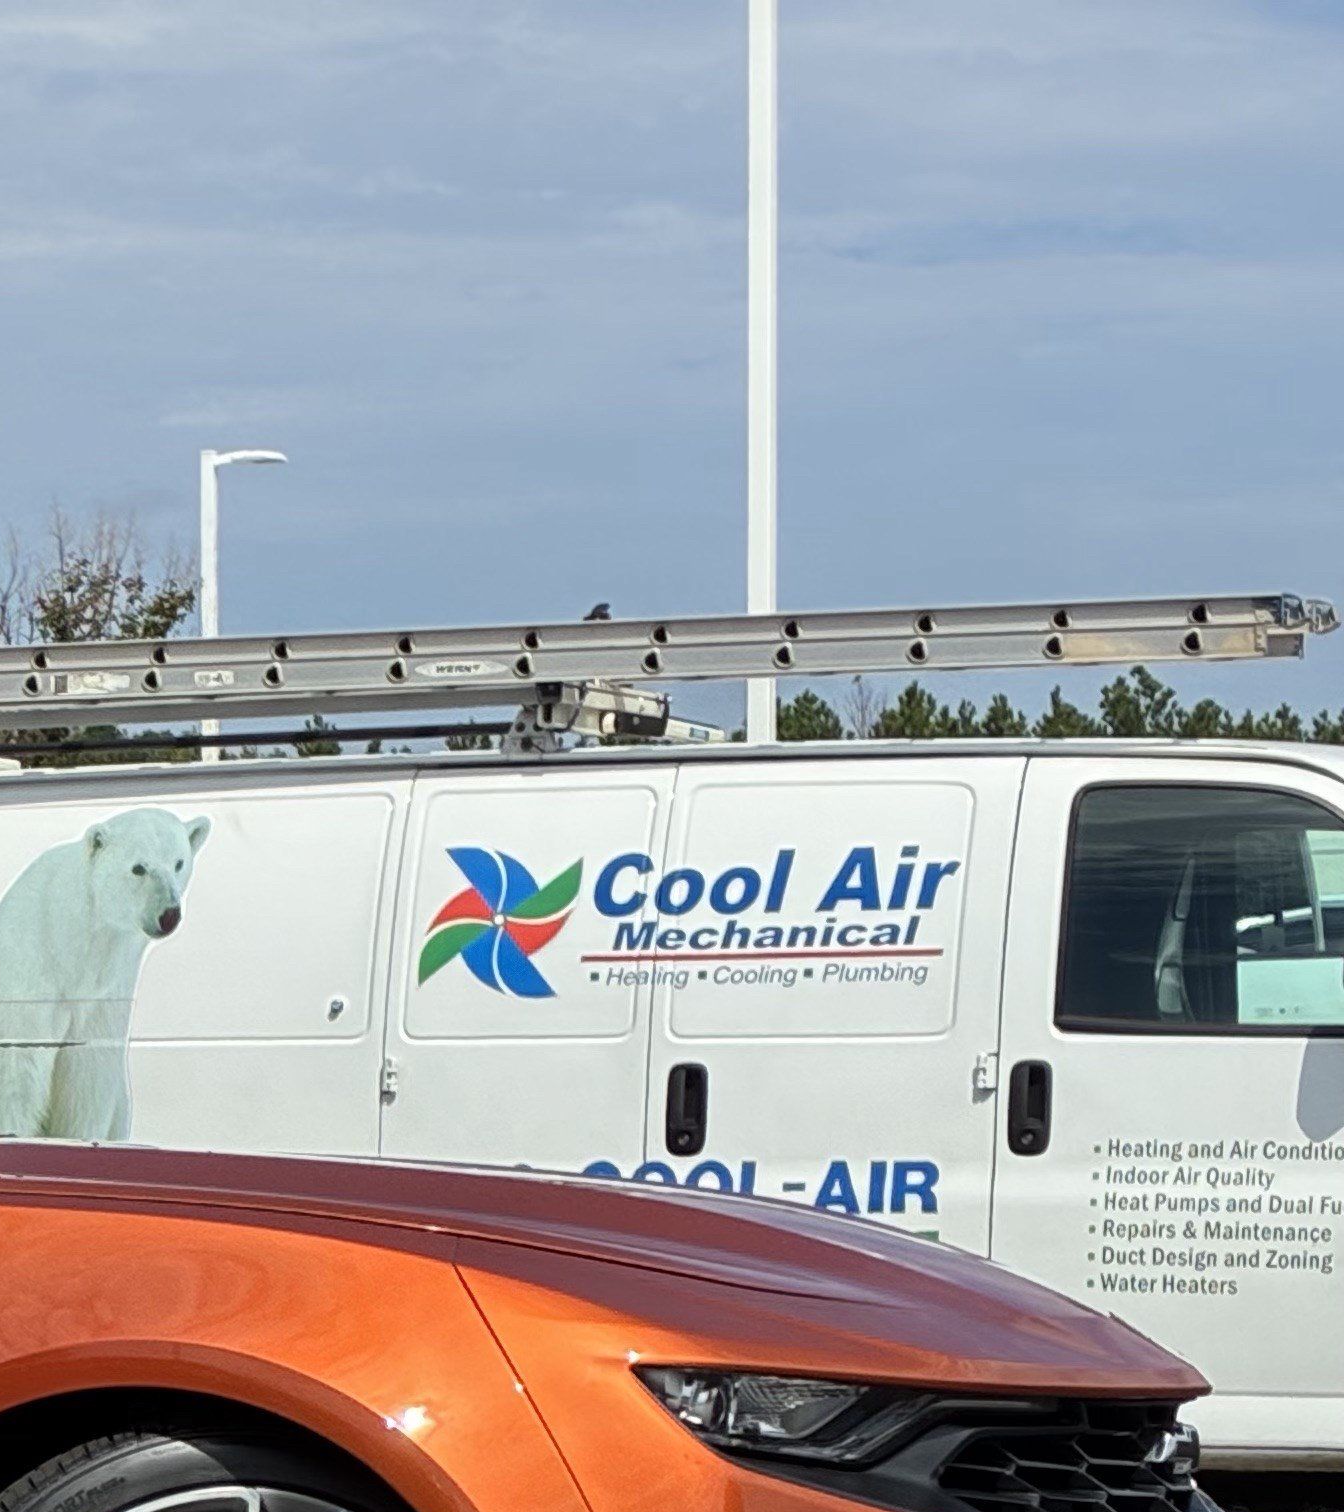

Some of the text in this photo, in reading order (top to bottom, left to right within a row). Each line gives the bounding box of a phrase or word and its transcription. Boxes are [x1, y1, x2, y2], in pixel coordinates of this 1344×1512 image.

[593, 844, 961, 918] Cool Air
[612, 915, 920, 952] Mechanical
[712, 964, 798, 987] Cooling
[822, 961, 929, 985] Plumbing
[1108, 1138, 1183, 1162] Heating
[1188, 1140, 1224, 1159] and
[1229, 1139, 1258, 1159] Air
[1106, 1166, 1276, 1191] Indoor Air Quality
[1104, 1192, 1148, 1211] Heat
[1154, 1193, 1220, 1216] Pumps
[1226, 1194, 1262, 1213] and
[1268, 1195, 1313, 1214] Dual
[1102, 1218, 1333, 1242] Repairs & Maintenance
[1101, 1246, 1334, 1274] Duct Design and Zoning
[1100, 1272, 1238, 1295] Water Heaters
